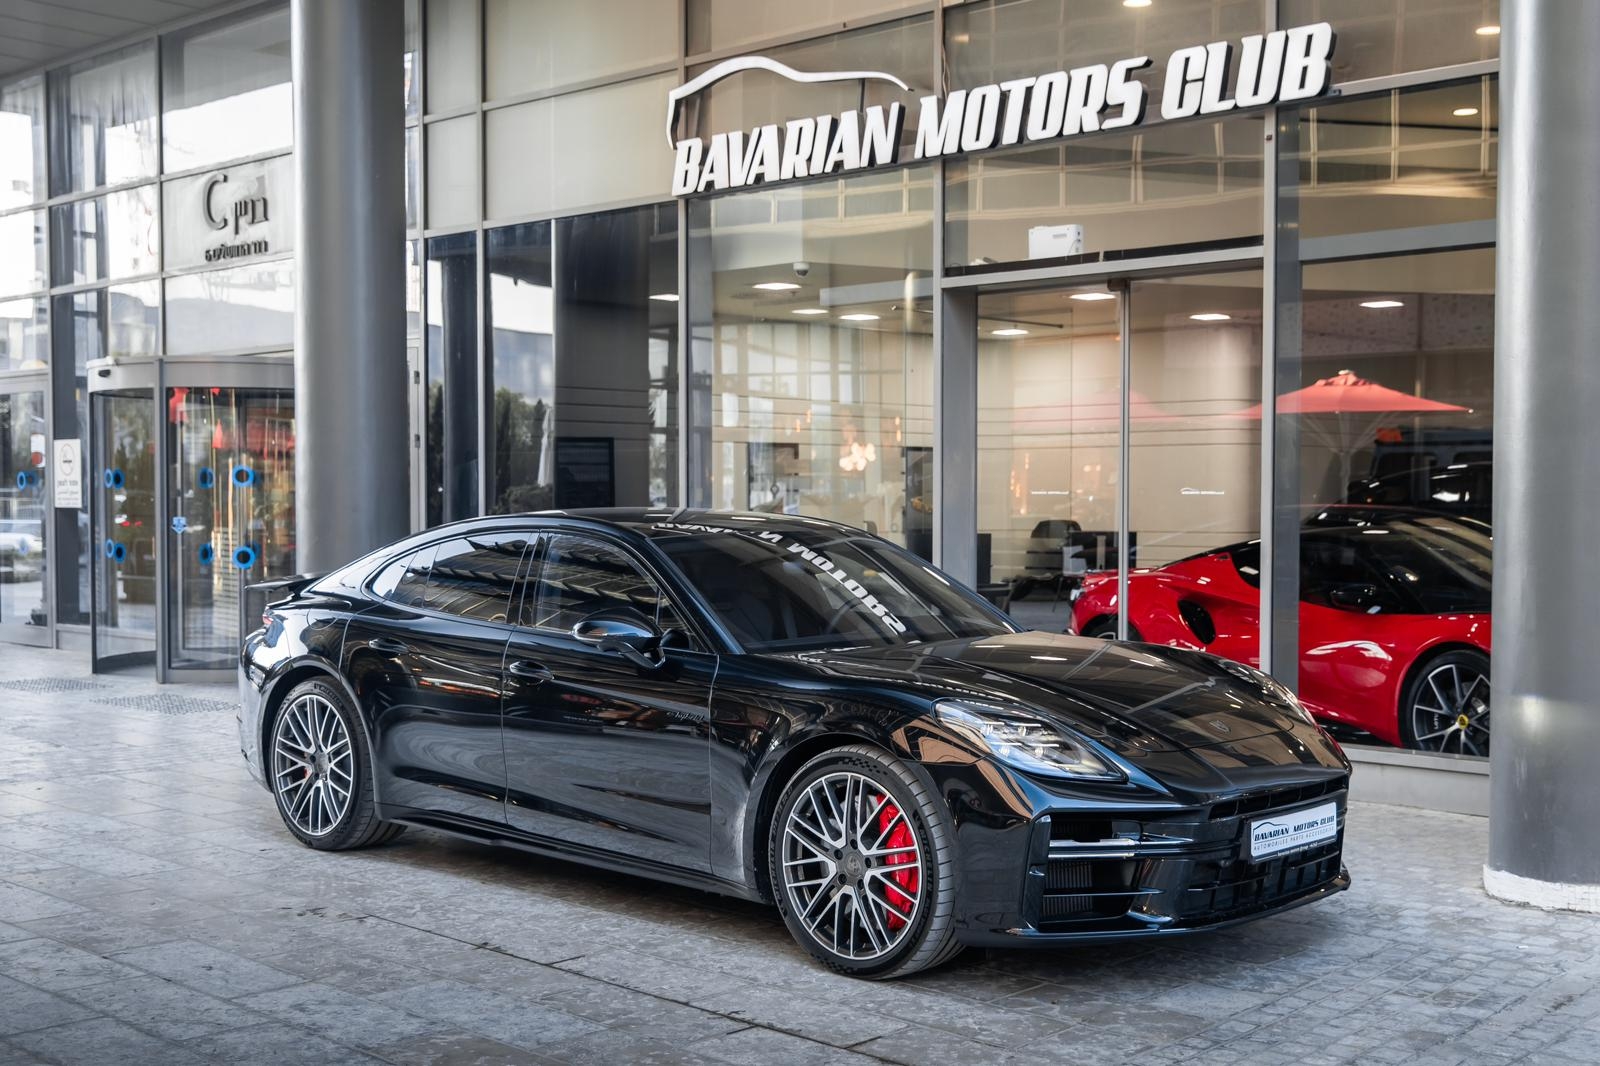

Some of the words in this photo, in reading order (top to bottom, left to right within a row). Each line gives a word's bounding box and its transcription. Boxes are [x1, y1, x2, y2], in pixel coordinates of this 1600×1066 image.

[671, 101, 902, 197] BAVARIAN
[914, 56, 1151, 159] MOTORS
[1160, 22, 1336, 121] CLUB
[203, 173, 229, 230] C
[1253, 838, 1289, 851] AUTOMOBILES
[1254, 827, 1290, 842] BAVARIAN
[1293, 819, 1319, 833] MOTORS
[1319, 815, 1335, 826] CLUB
[918, 823, 933, 893] MICHELIN
